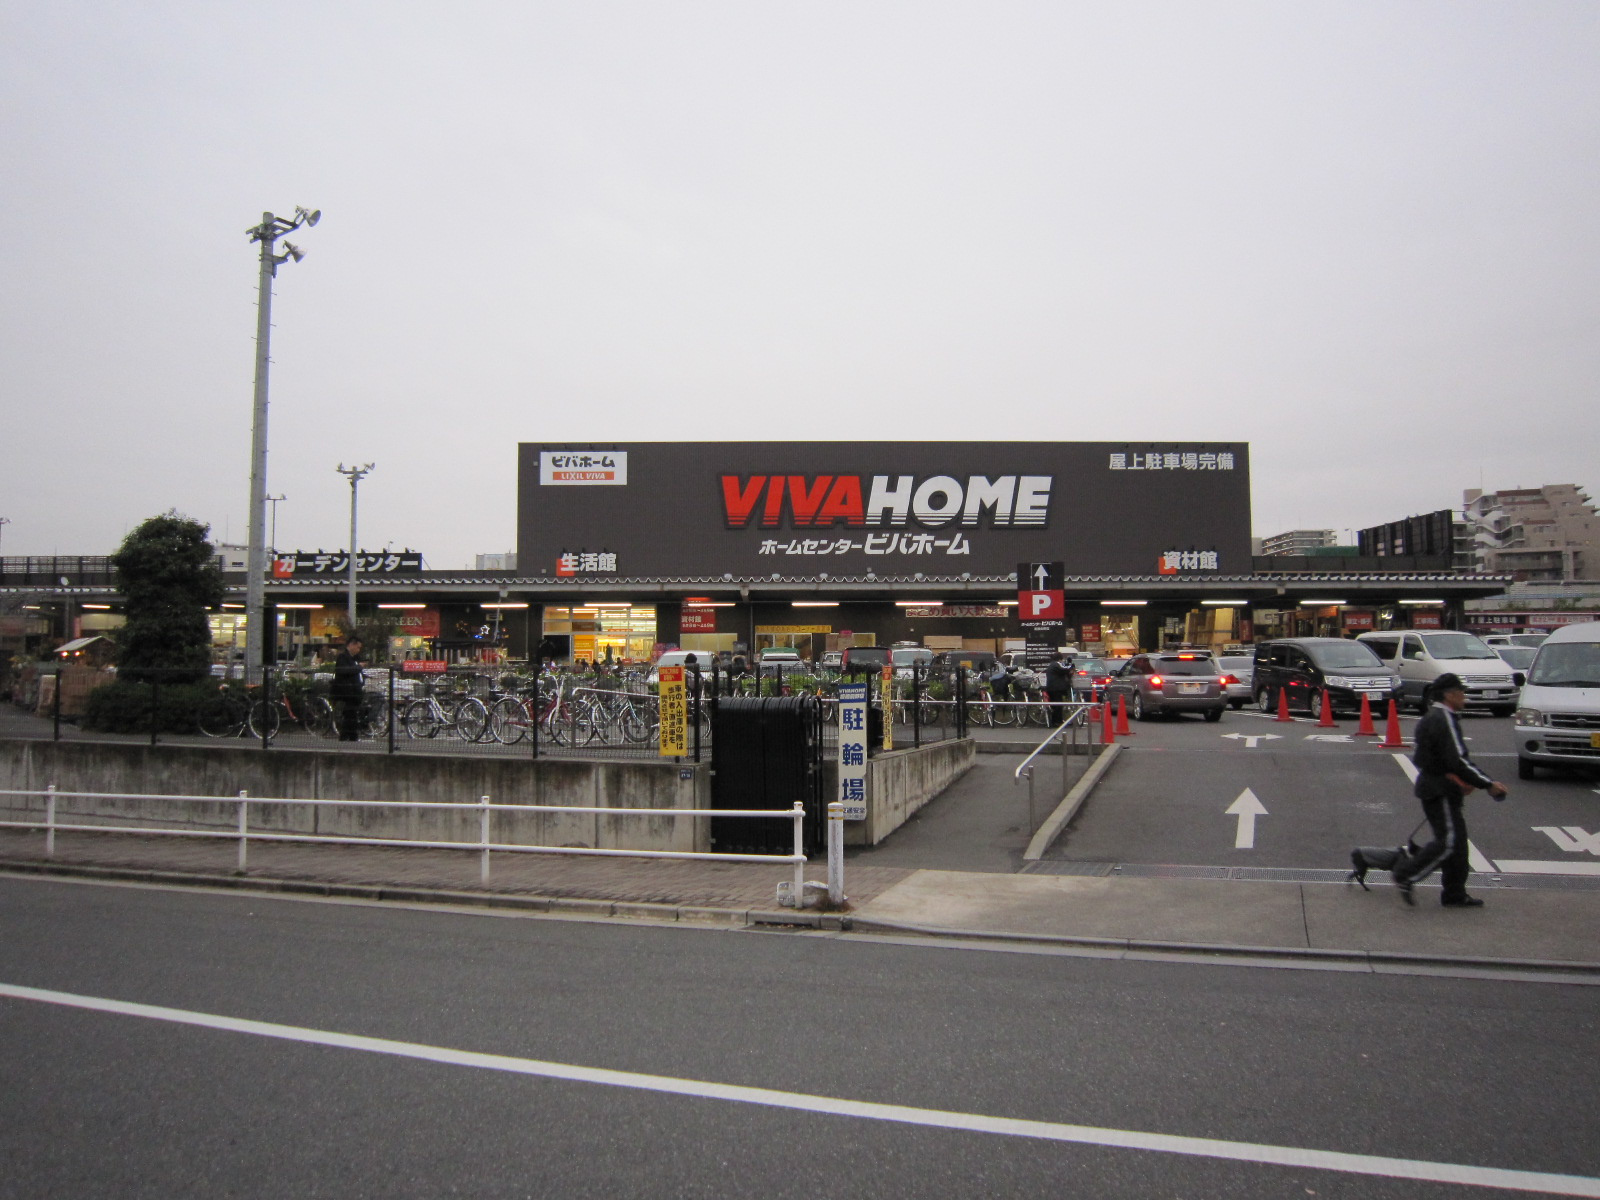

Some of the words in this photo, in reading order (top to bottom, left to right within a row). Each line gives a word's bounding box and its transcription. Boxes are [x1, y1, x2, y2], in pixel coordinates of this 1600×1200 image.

[551, 456, 616, 468] ビバホーム
[1109, 453, 1234, 470] 屋上駐車場完備
[280, 555, 418, 572] ガーデンセンター
[560, 553, 617, 572] 生活館
[1163, 551, 1218, 570] 資材館
[1032, 595, 1052, 615] P
[842, 708, 864, 802] 駐輪場
